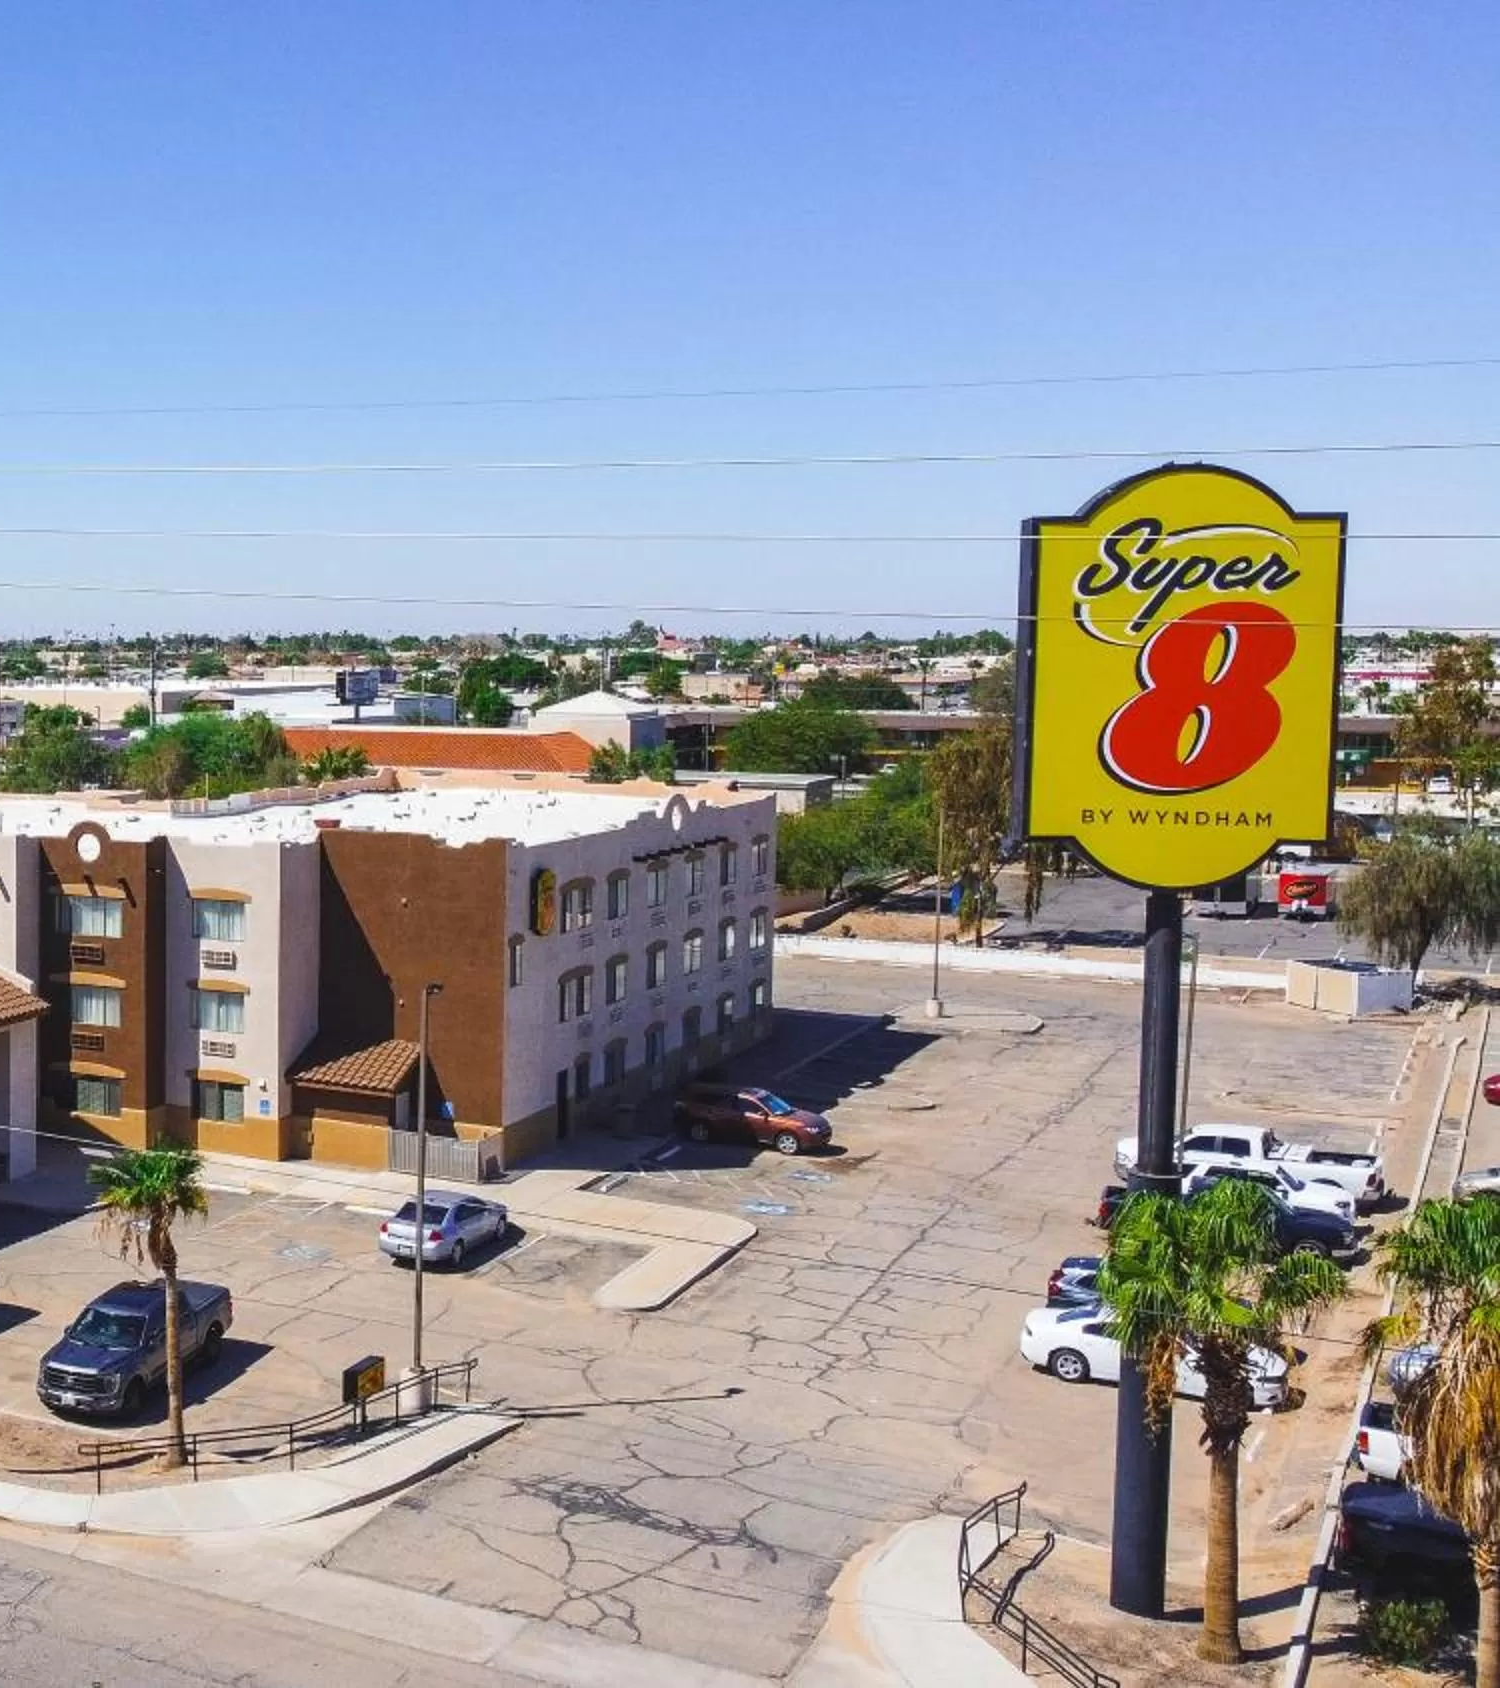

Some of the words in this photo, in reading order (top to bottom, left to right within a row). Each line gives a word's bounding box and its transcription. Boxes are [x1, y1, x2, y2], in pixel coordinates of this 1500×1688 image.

[1075, 517, 1300, 635] Super
[1097, 601, 1297, 795] 8
[1081, 808, 1113, 824] BY
[1129, 810, 1272, 827] WYNDHAM
